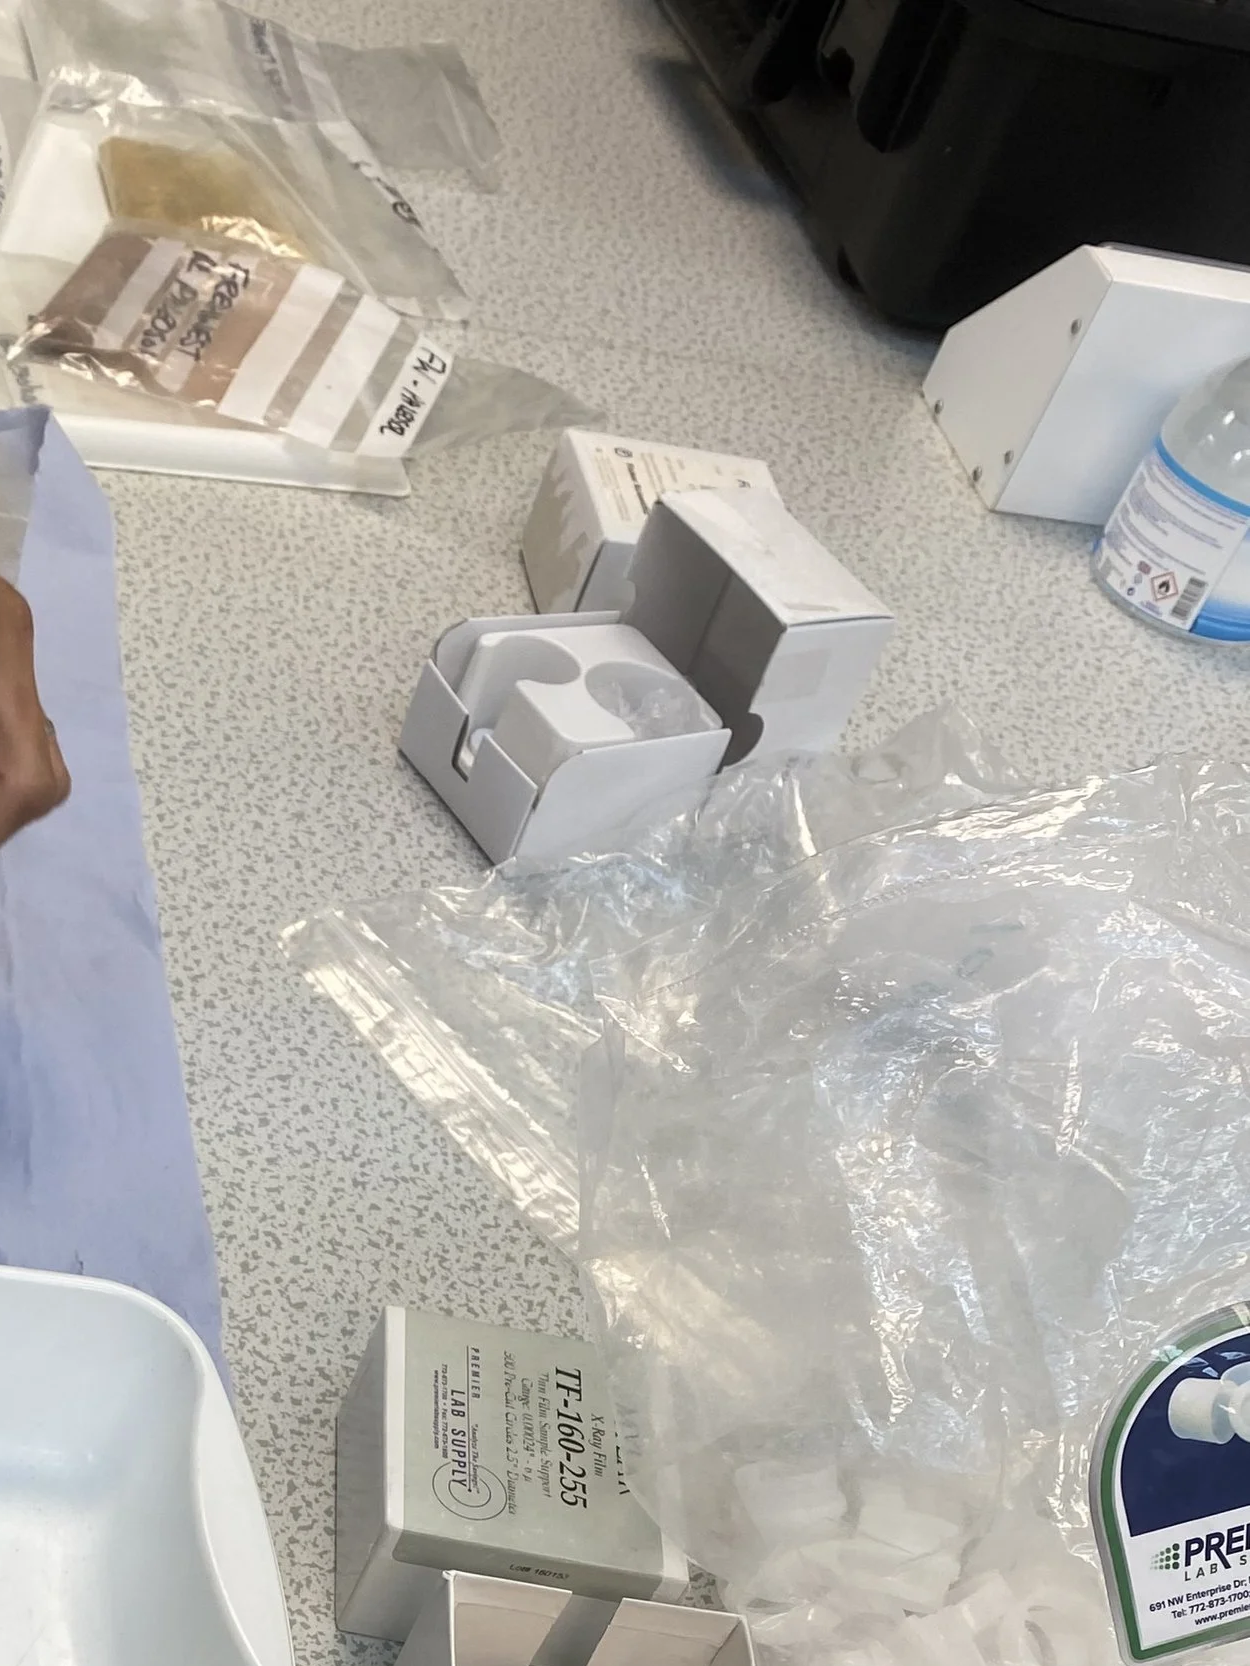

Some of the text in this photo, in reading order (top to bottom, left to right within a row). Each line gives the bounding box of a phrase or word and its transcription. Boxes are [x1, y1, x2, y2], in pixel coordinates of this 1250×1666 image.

[471, 1347, 480, 1399] PREMIER
[451, 1389, 467, 1488] LAB SUPPLY
[537, 1421, 551, 1457] Sample
[555, 1366, 587, 1508] TF-160-255
[588, 1413, 607, 1477] X-Ray Film
[537, 1458, 552, 1498] Support
[1184, 1523, 1250, 1569] PRE
[1184, 1563, 1218, 1581] LAB
[1149, 1600, 1166, 1612] 691
[1167, 1595, 1184, 1607] NW
[1186, 1584, 1231, 1602] Enterprise
